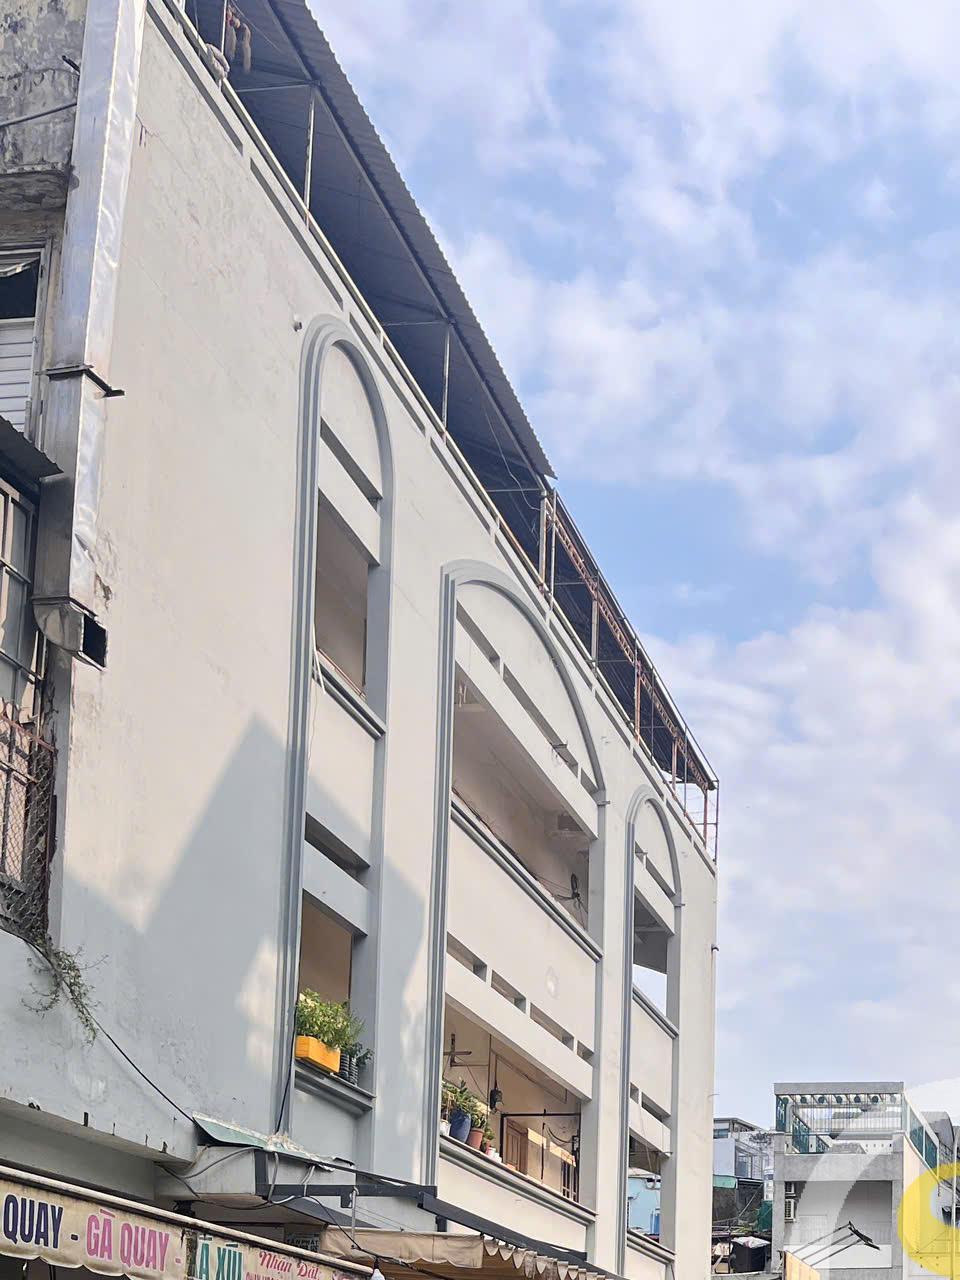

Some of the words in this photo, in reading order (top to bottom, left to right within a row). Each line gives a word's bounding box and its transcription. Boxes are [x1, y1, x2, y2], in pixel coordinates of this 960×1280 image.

[3, 1194, 64, 1249] QUAY
[86, 1209, 116, 1260] GÀ
[119, 1222, 170, 1272] QUAY
